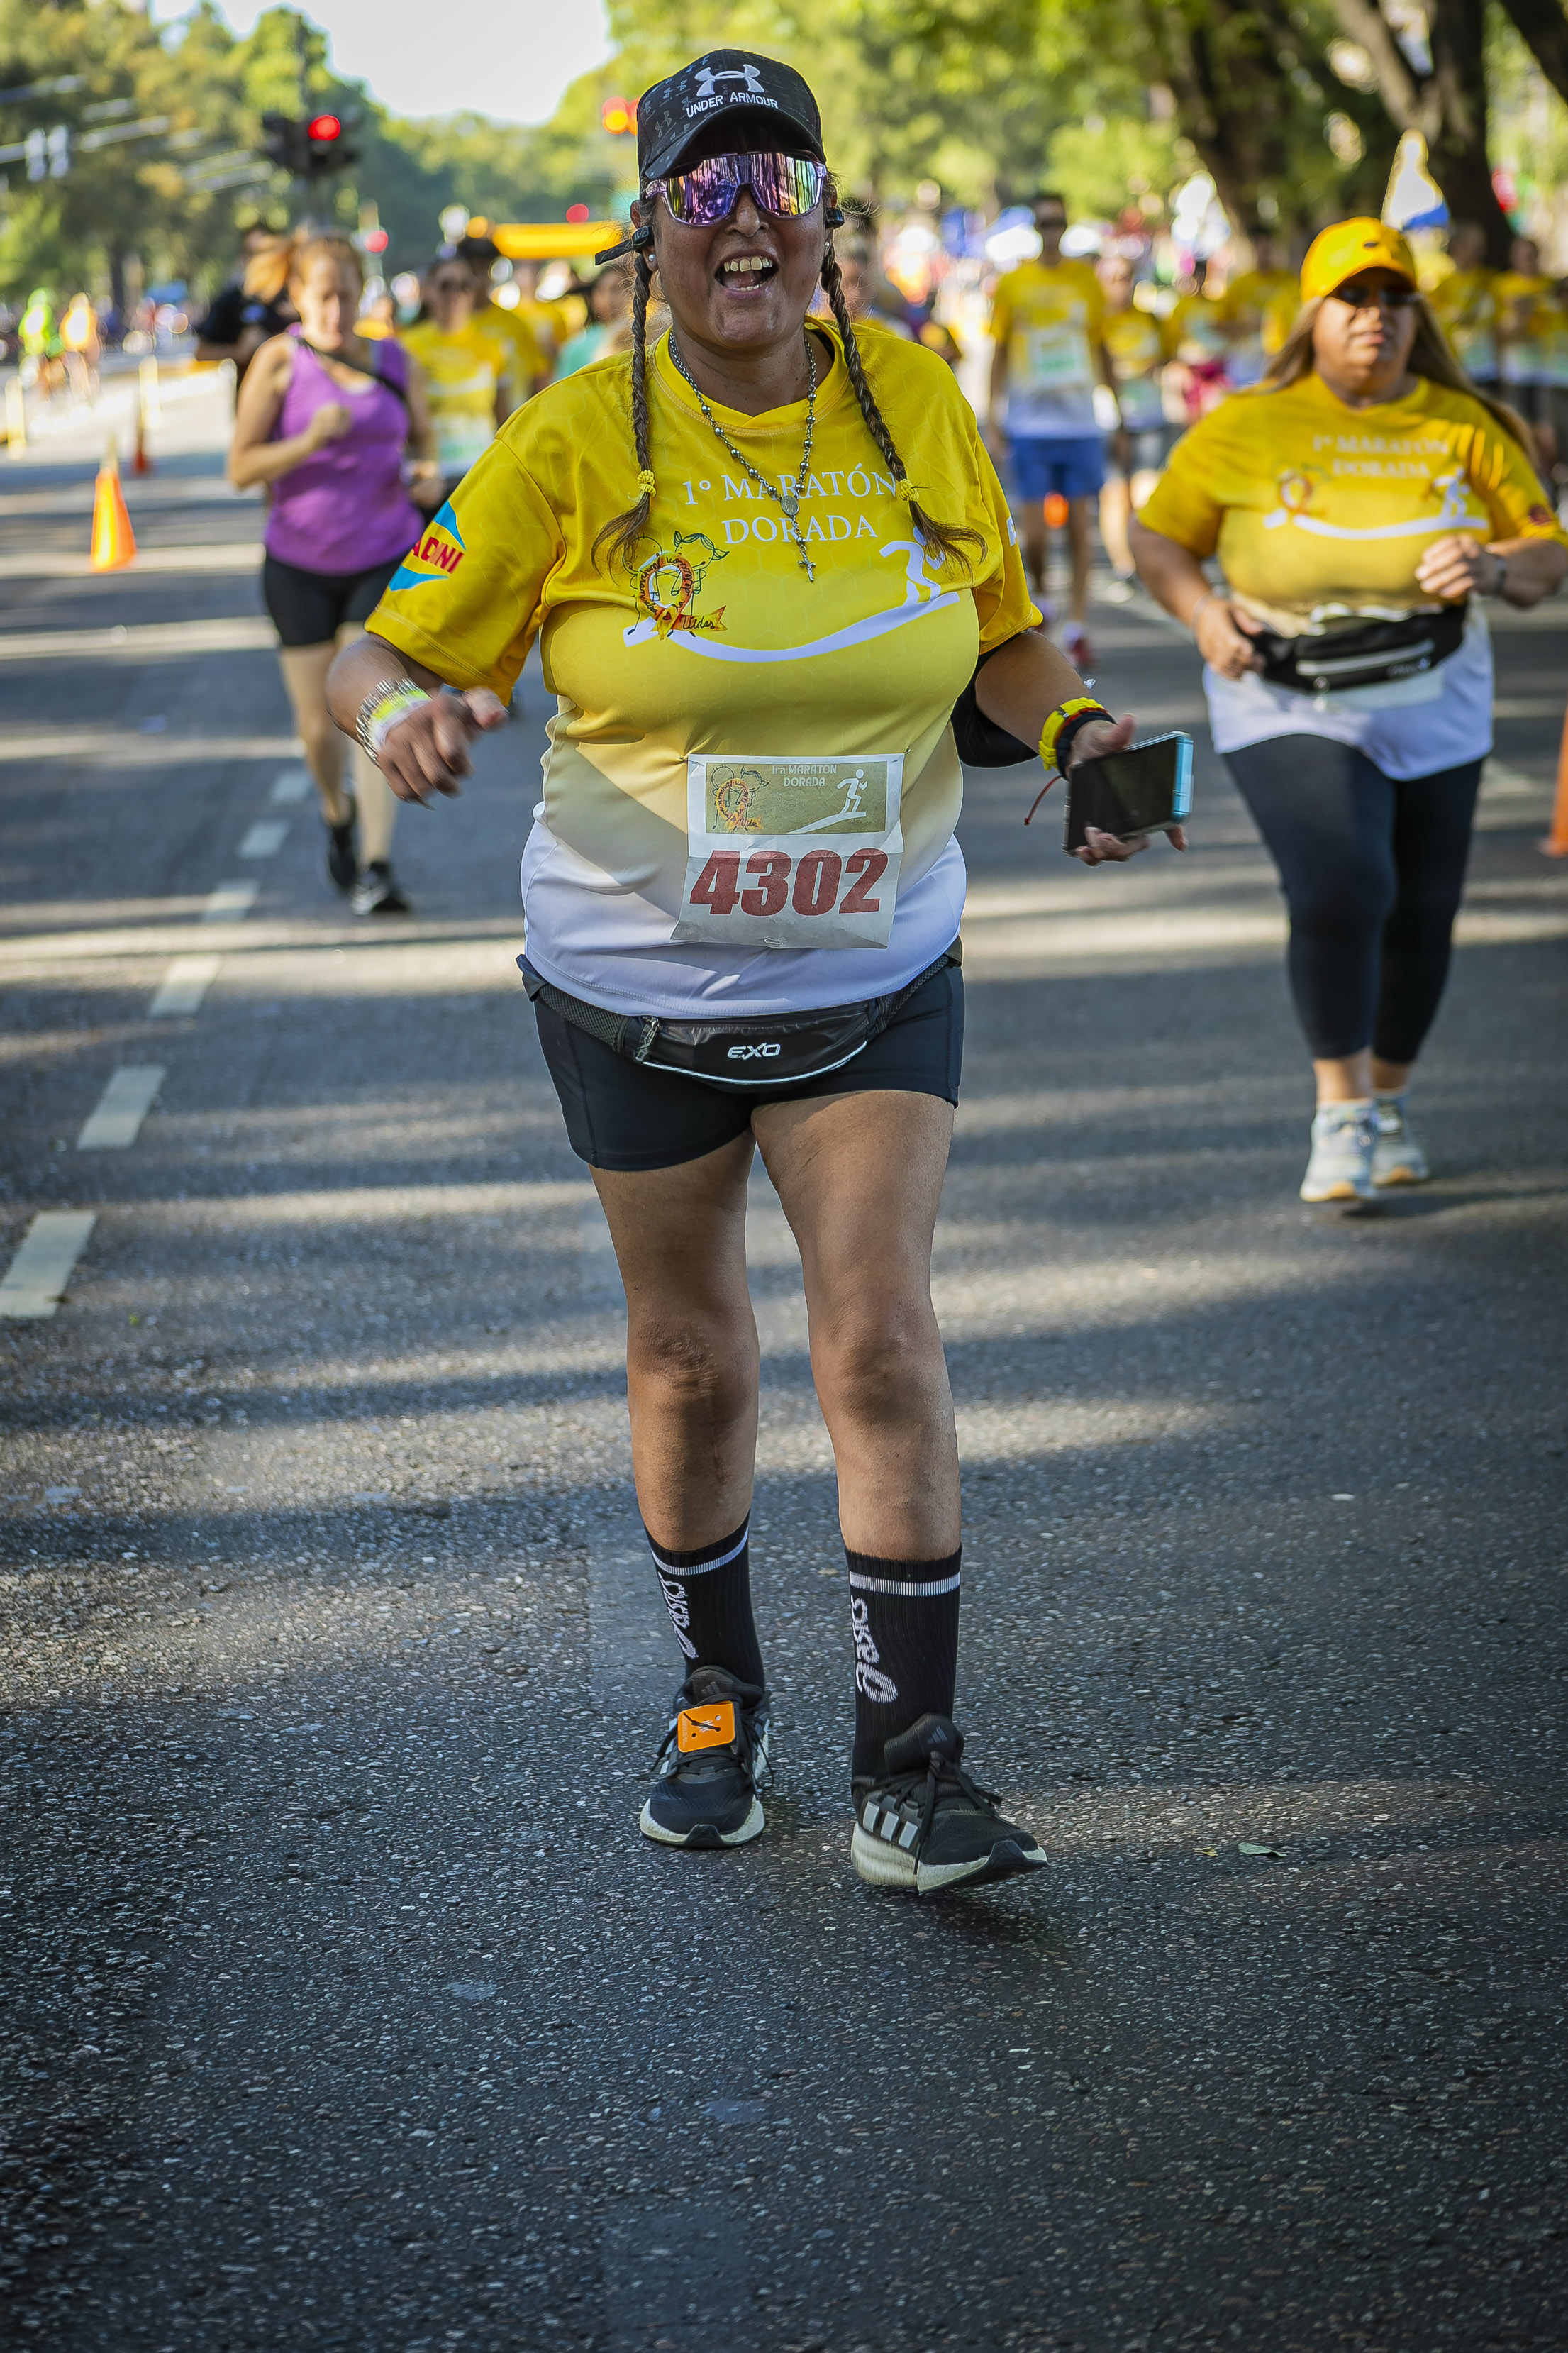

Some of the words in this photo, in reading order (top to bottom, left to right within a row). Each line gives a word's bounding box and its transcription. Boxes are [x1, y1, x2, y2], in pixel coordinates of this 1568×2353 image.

[686, 94, 723, 118] UNDER
[730, 91, 779, 109] ARMOUR
[721, 514, 878, 544] DORADA
[788, 765, 837, 775] MARATON
[784, 777, 825, 787] DORADA
[689, 847, 889, 917] 4302
[728, 1042, 781, 1060] EXO
